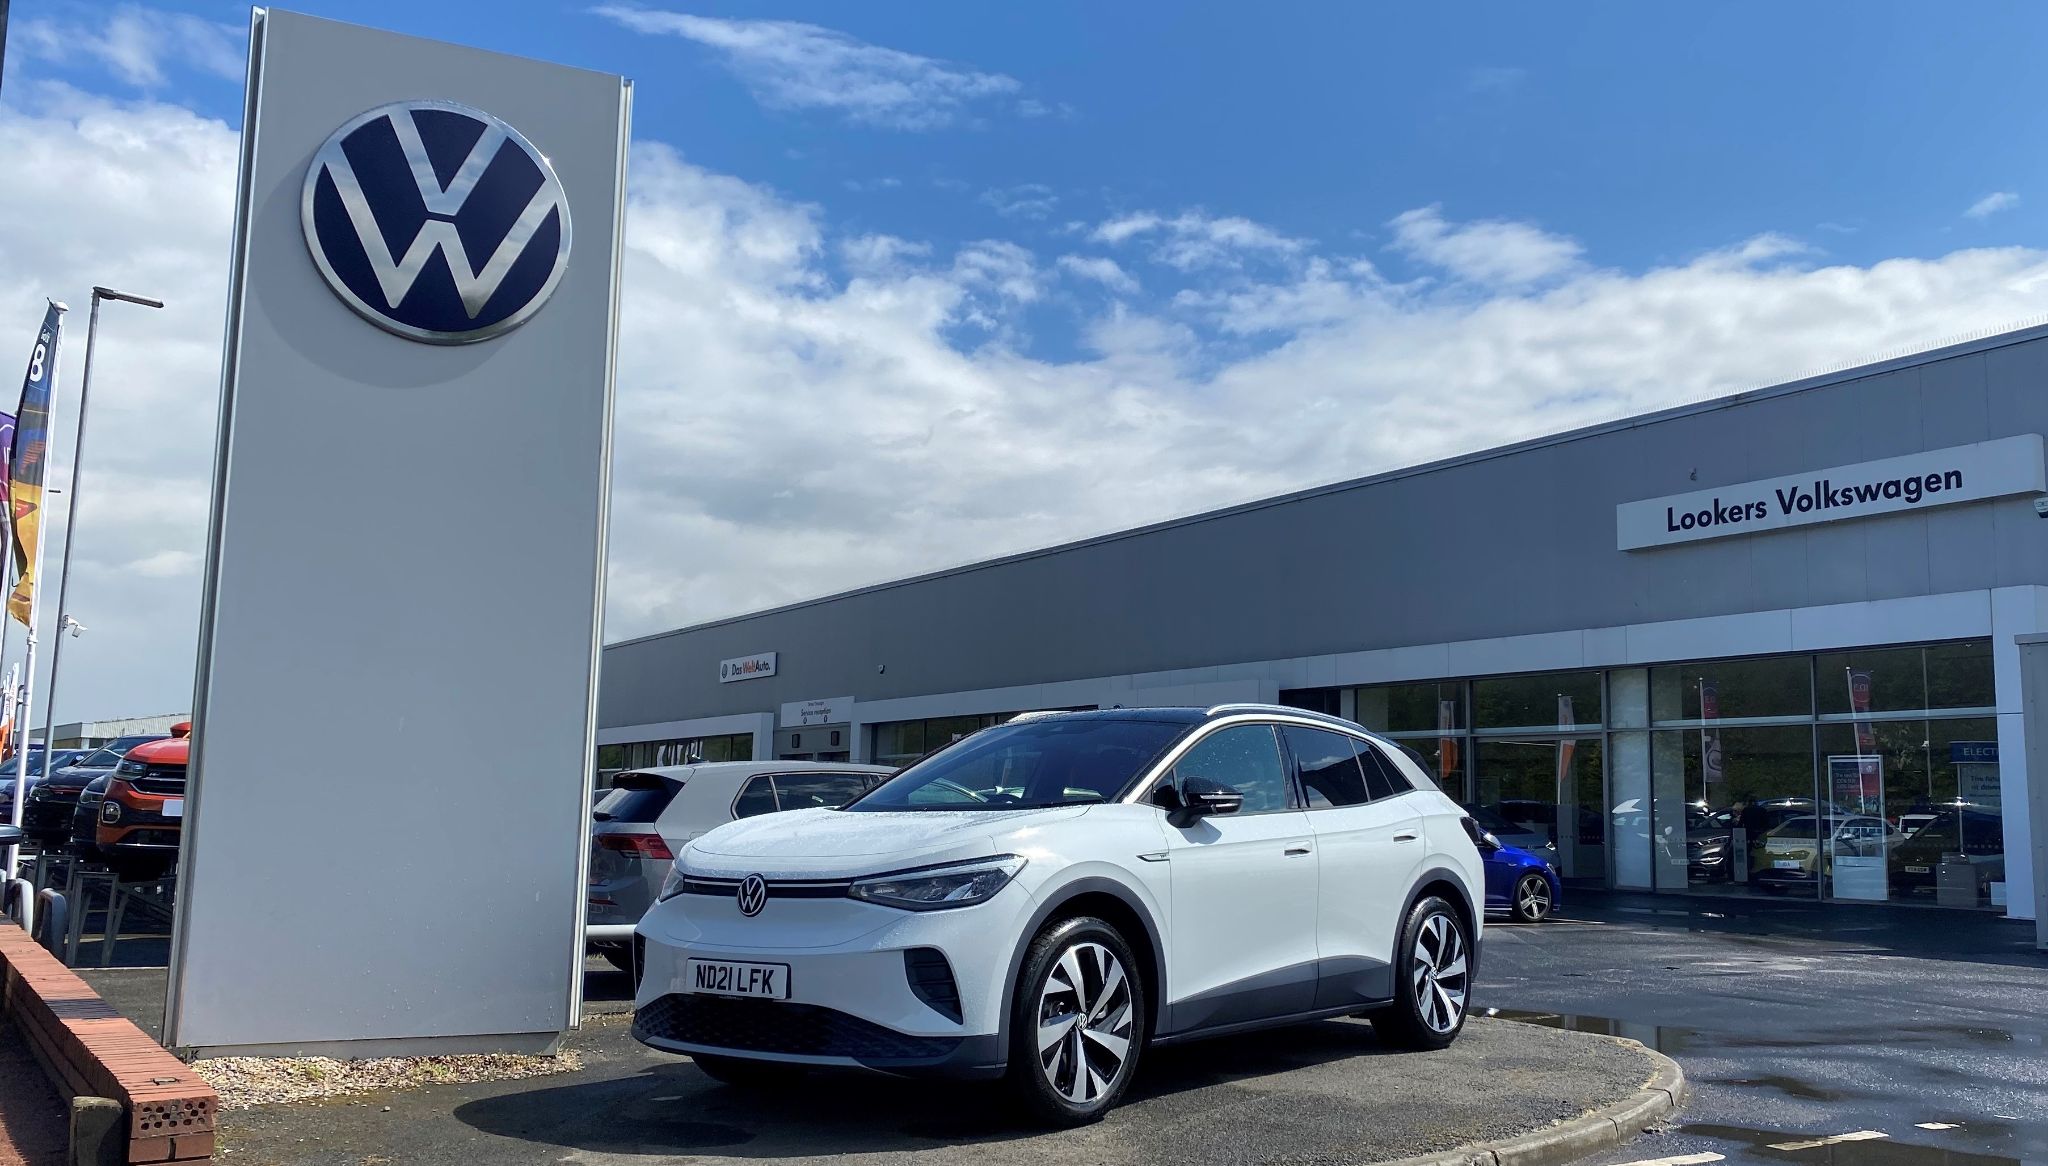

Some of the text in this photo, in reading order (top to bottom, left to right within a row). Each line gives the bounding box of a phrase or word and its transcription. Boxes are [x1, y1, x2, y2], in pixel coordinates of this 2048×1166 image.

[29, 343, 46, 382] 8
[1667, 469, 1964, 532] Lookers Volkswagen
[731, 663, 743, 676] Das
[1963, 747, 1999, 756] ELECT
[696, 964, 774, 994] ND21 LFK
